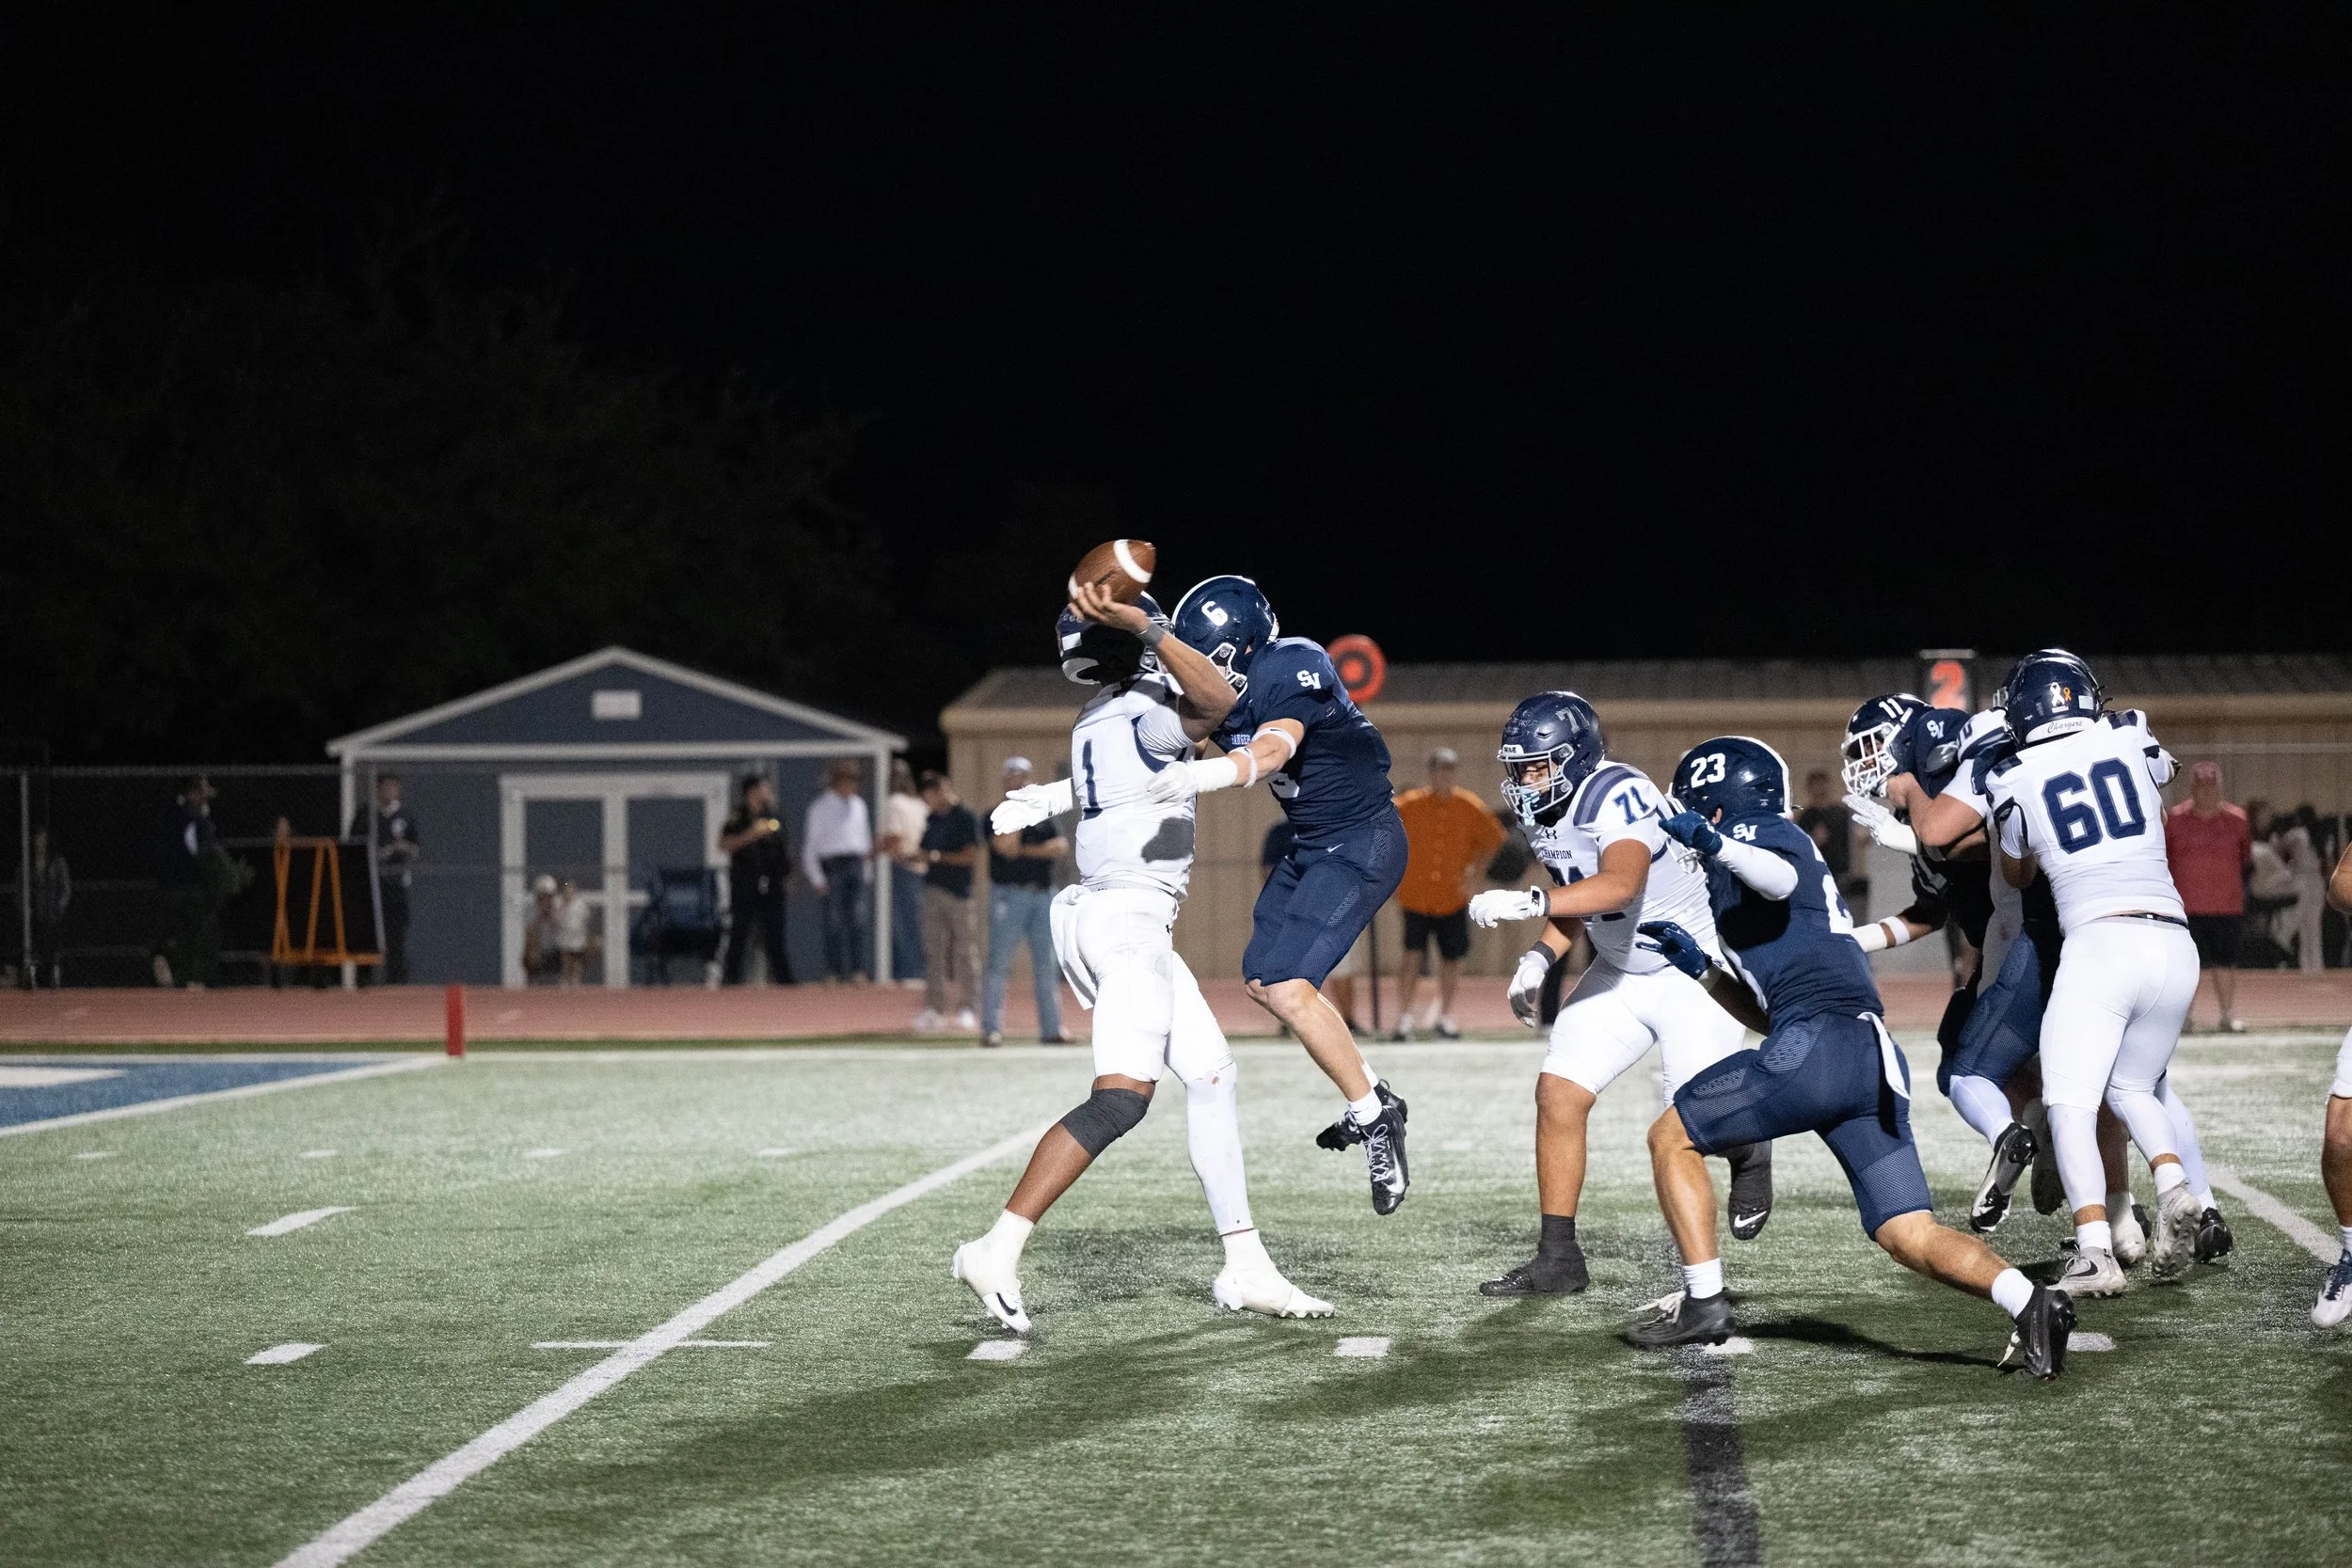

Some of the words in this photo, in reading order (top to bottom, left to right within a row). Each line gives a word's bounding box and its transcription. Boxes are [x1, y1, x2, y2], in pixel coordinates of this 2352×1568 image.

[1201, 600, 1229, 626] 6
[1296, 670, 1322, 689] SV
[1930, 659, 1968, 710] 2
[1879, 698, 1904, 719] 11
[1926, 720, 1945, 739] SV
[2047, 721, 2083, 734] Chargers
[1082, 738, 1104, 821] 1
[1691, 752, 1725, 788] 23
[1613, 785, 1649, 826] 71
[2042, 757, 2146, 854] 60
[1732, 823, 1758, 842] SV
